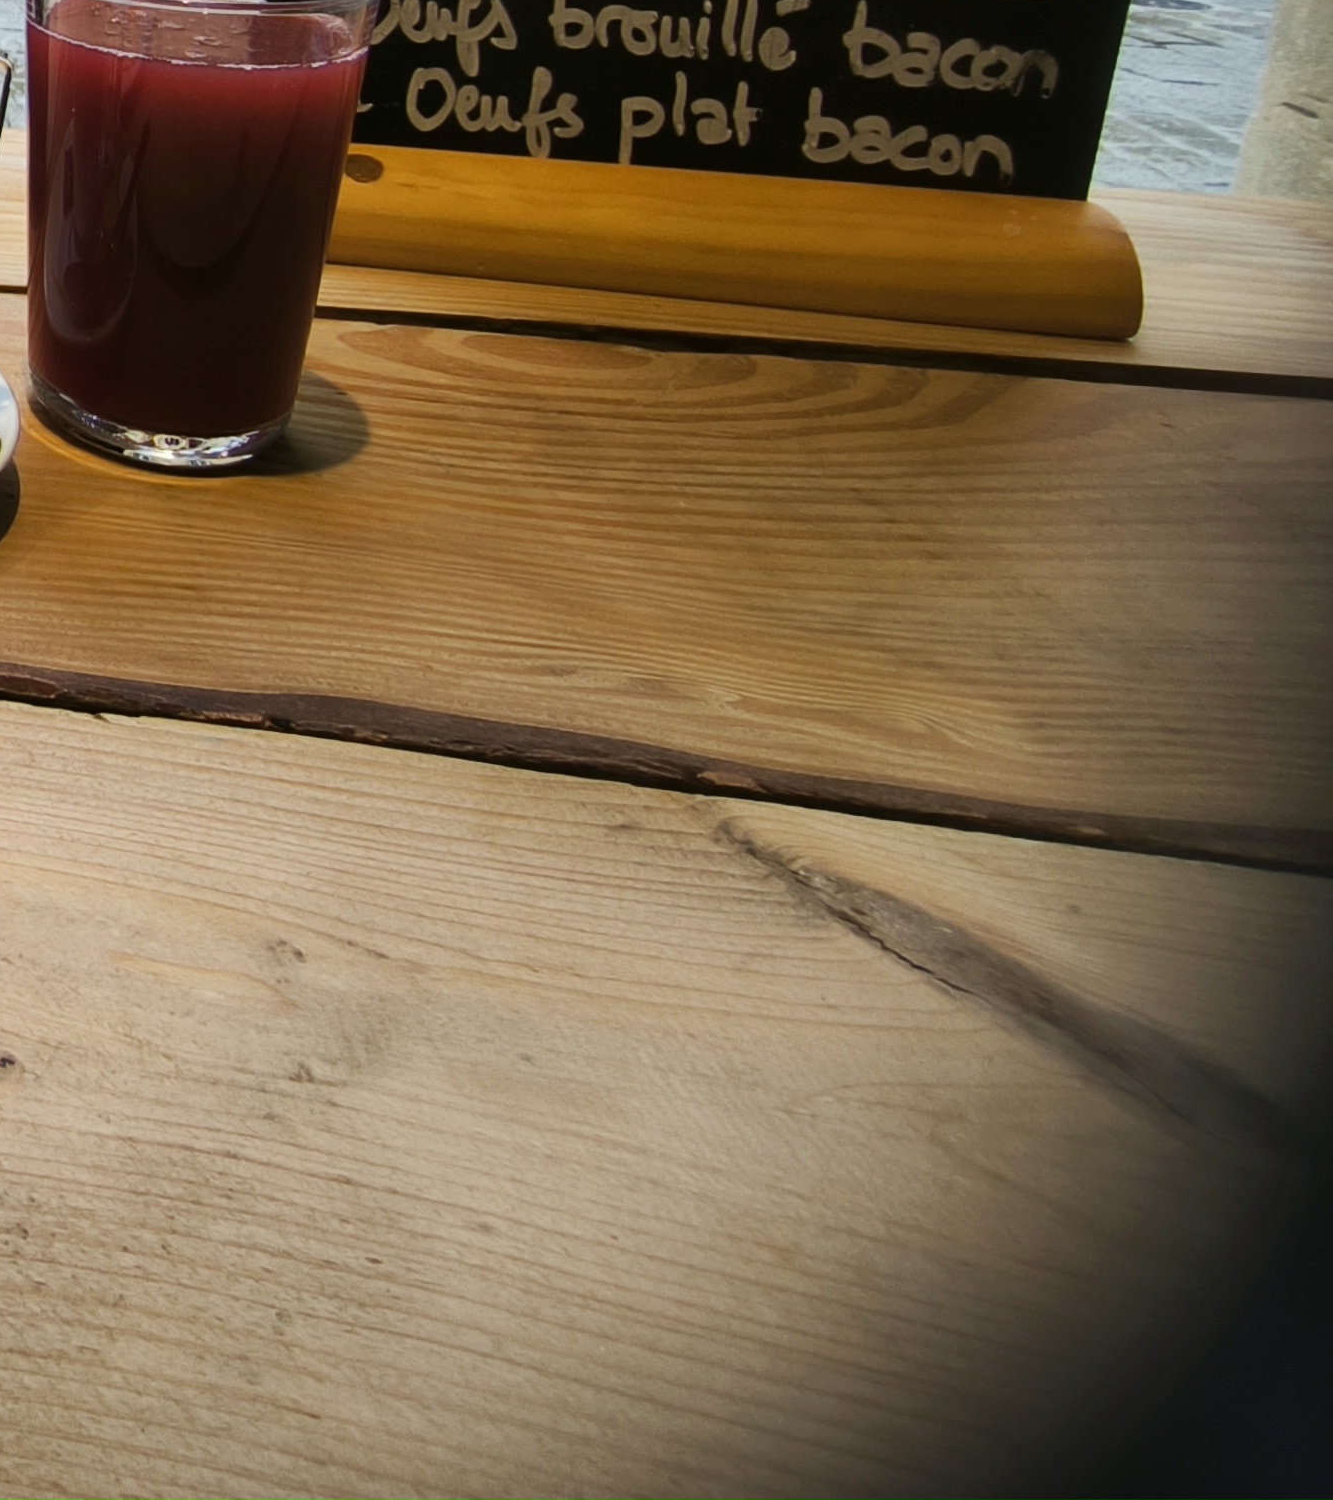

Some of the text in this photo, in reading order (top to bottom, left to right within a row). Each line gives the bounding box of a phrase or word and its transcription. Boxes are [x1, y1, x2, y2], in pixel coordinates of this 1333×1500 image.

[843, 0, 1058, 100] bacon
[406, 66, 1013, 187] Oeufs plat bacon
